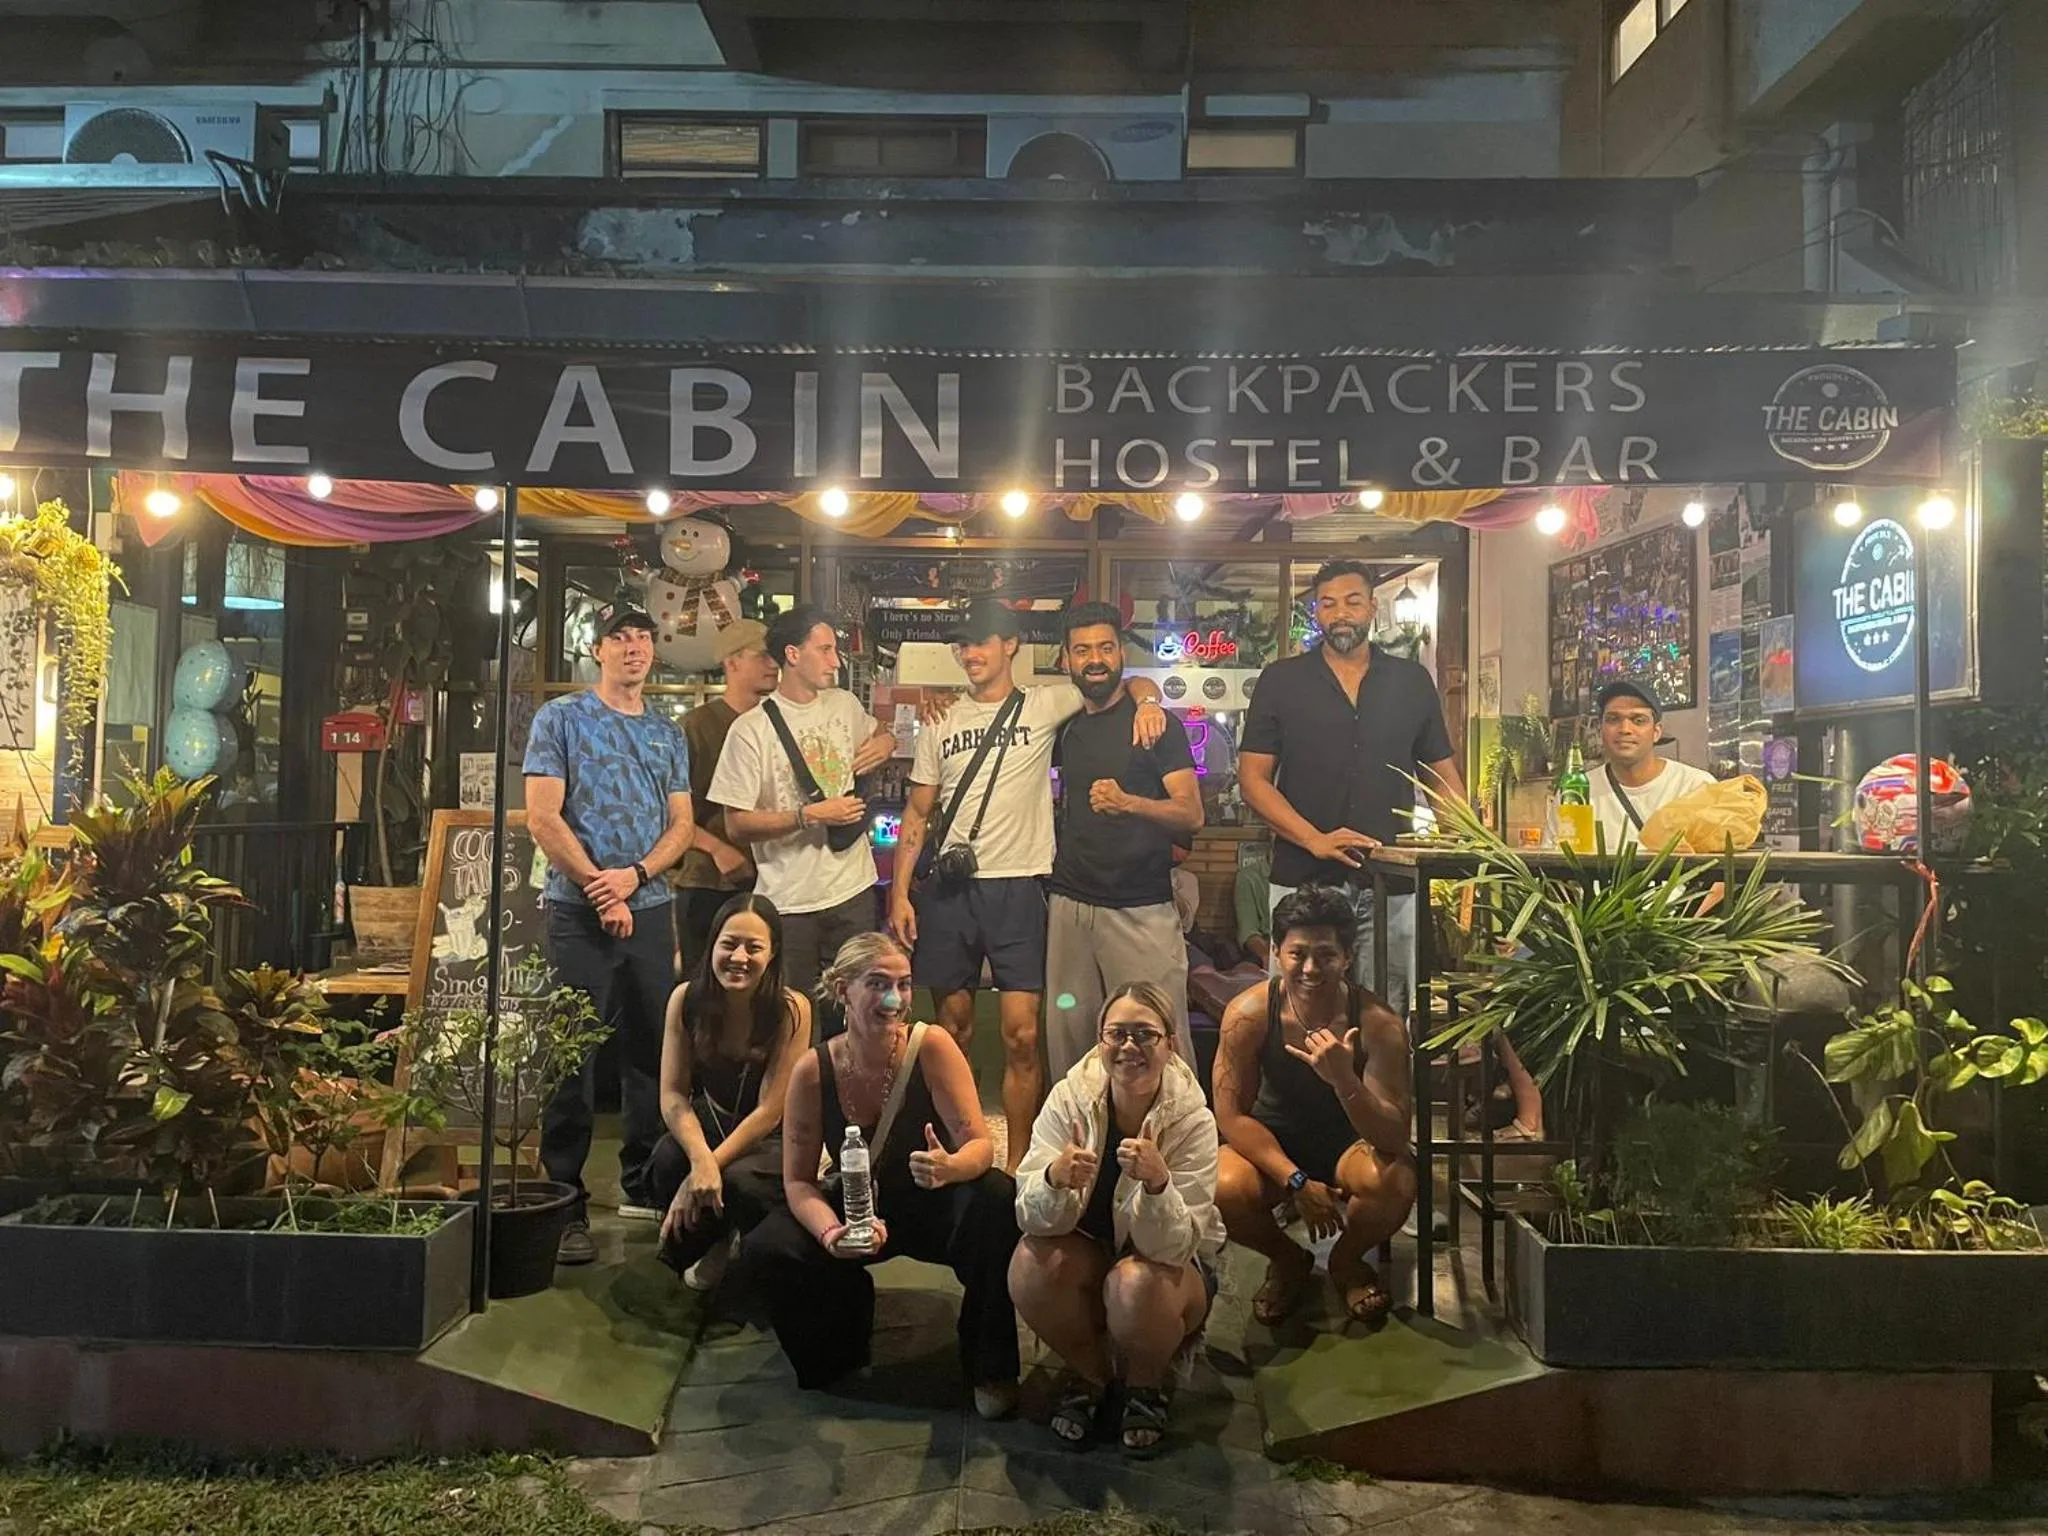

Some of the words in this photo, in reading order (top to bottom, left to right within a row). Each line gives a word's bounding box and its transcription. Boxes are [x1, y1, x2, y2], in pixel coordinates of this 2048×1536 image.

[1056, 361, 1646, 414] BACKPACKERS
[0, 352, 311, 464] THE
[399, 360, 960, 478] CABIN
[1761, 406, 1811, 431] THE
[1818, 405, 1899, 431] CABIN
[1055, 438, 1373, 489] HOSTEL
[1411, 437, 1462, 486] &
[1502, 436, 1660, 485] BAR
[1832, 582, 1867, 619] THE
[1182, 631, 1237, 660] Coffee
[942, 726, 1031, 759] CARHRTT
